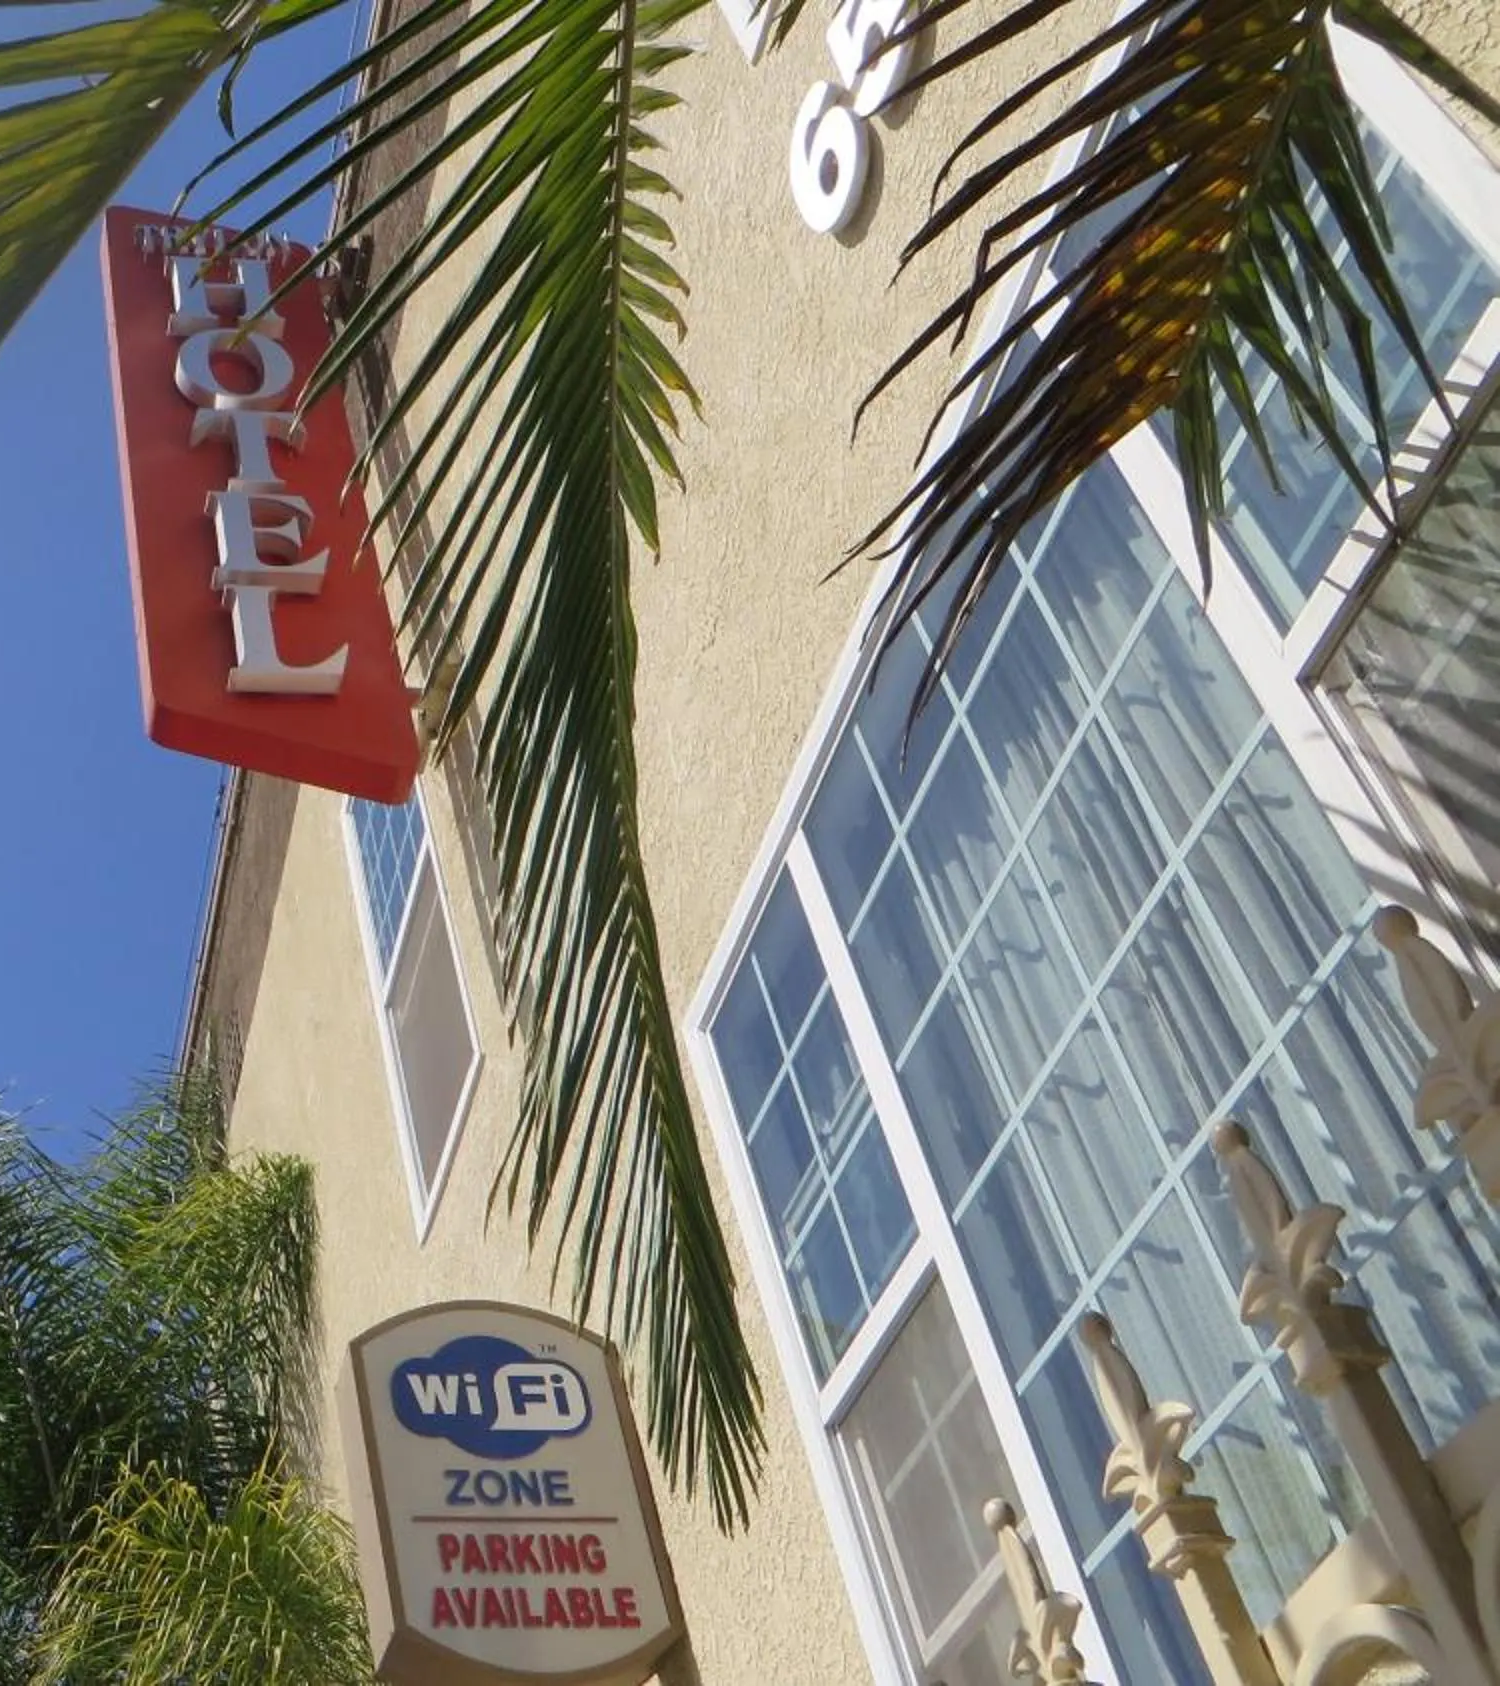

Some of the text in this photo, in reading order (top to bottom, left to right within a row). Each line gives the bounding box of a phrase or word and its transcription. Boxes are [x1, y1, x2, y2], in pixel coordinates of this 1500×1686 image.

[164, 254, 349, 694] HOTEL
[443, 1469, 574, 1507] ZONE
[437, 1533, 607, 1574] PARKING
[431, 1587, 641, 1629] AVAILABLE
